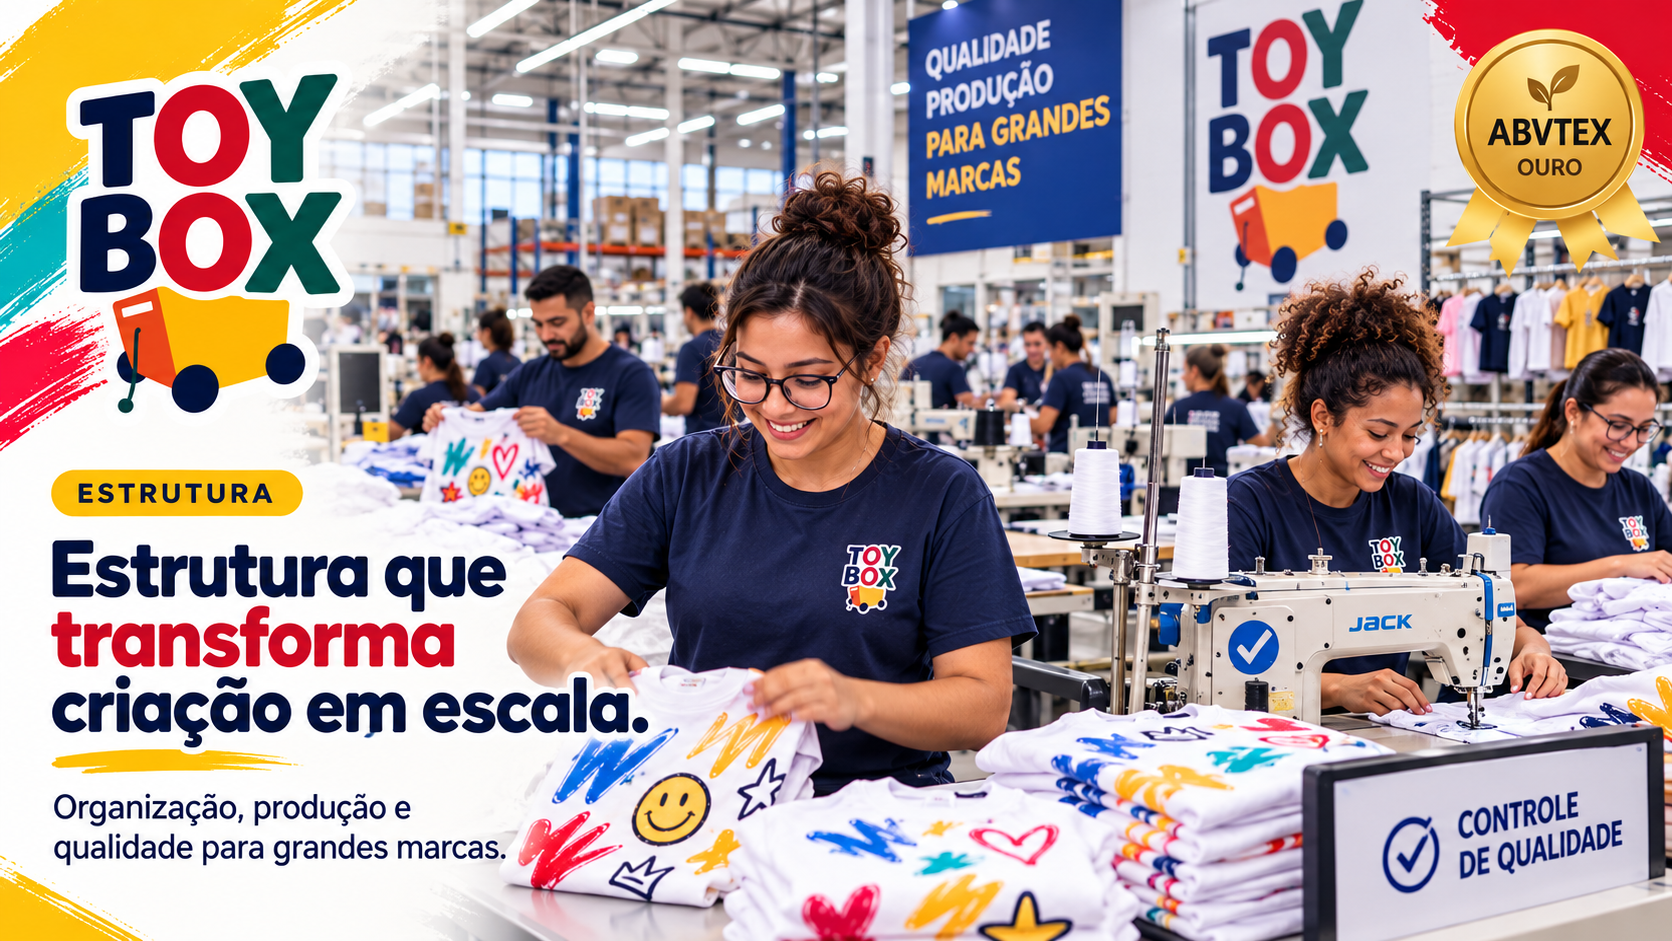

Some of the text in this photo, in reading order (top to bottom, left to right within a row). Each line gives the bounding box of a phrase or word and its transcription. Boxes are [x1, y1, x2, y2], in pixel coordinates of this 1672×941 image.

[925, 19, 1051, 81] QUALIDADE
[1208, 0, 1364, 108] TOY
[926, 60, 1054, 119] PRODUÇÃO
[926, 95, 1111, 159] PARA GRANDES
[1209, 89, 1369, 193] BOX
[926, 156, 1022, 199] MARCAS
[849, 546, 899, 567] TOY
[1370, 537, 1400, 554] TOY
[1373, 552, 1405, 568] BOX
[843, 566, 896, 589] BOX
[1458, 791, 1579, 839] CONTROLE
[1460, 820, 1623, 879] DE QUALIDADE
